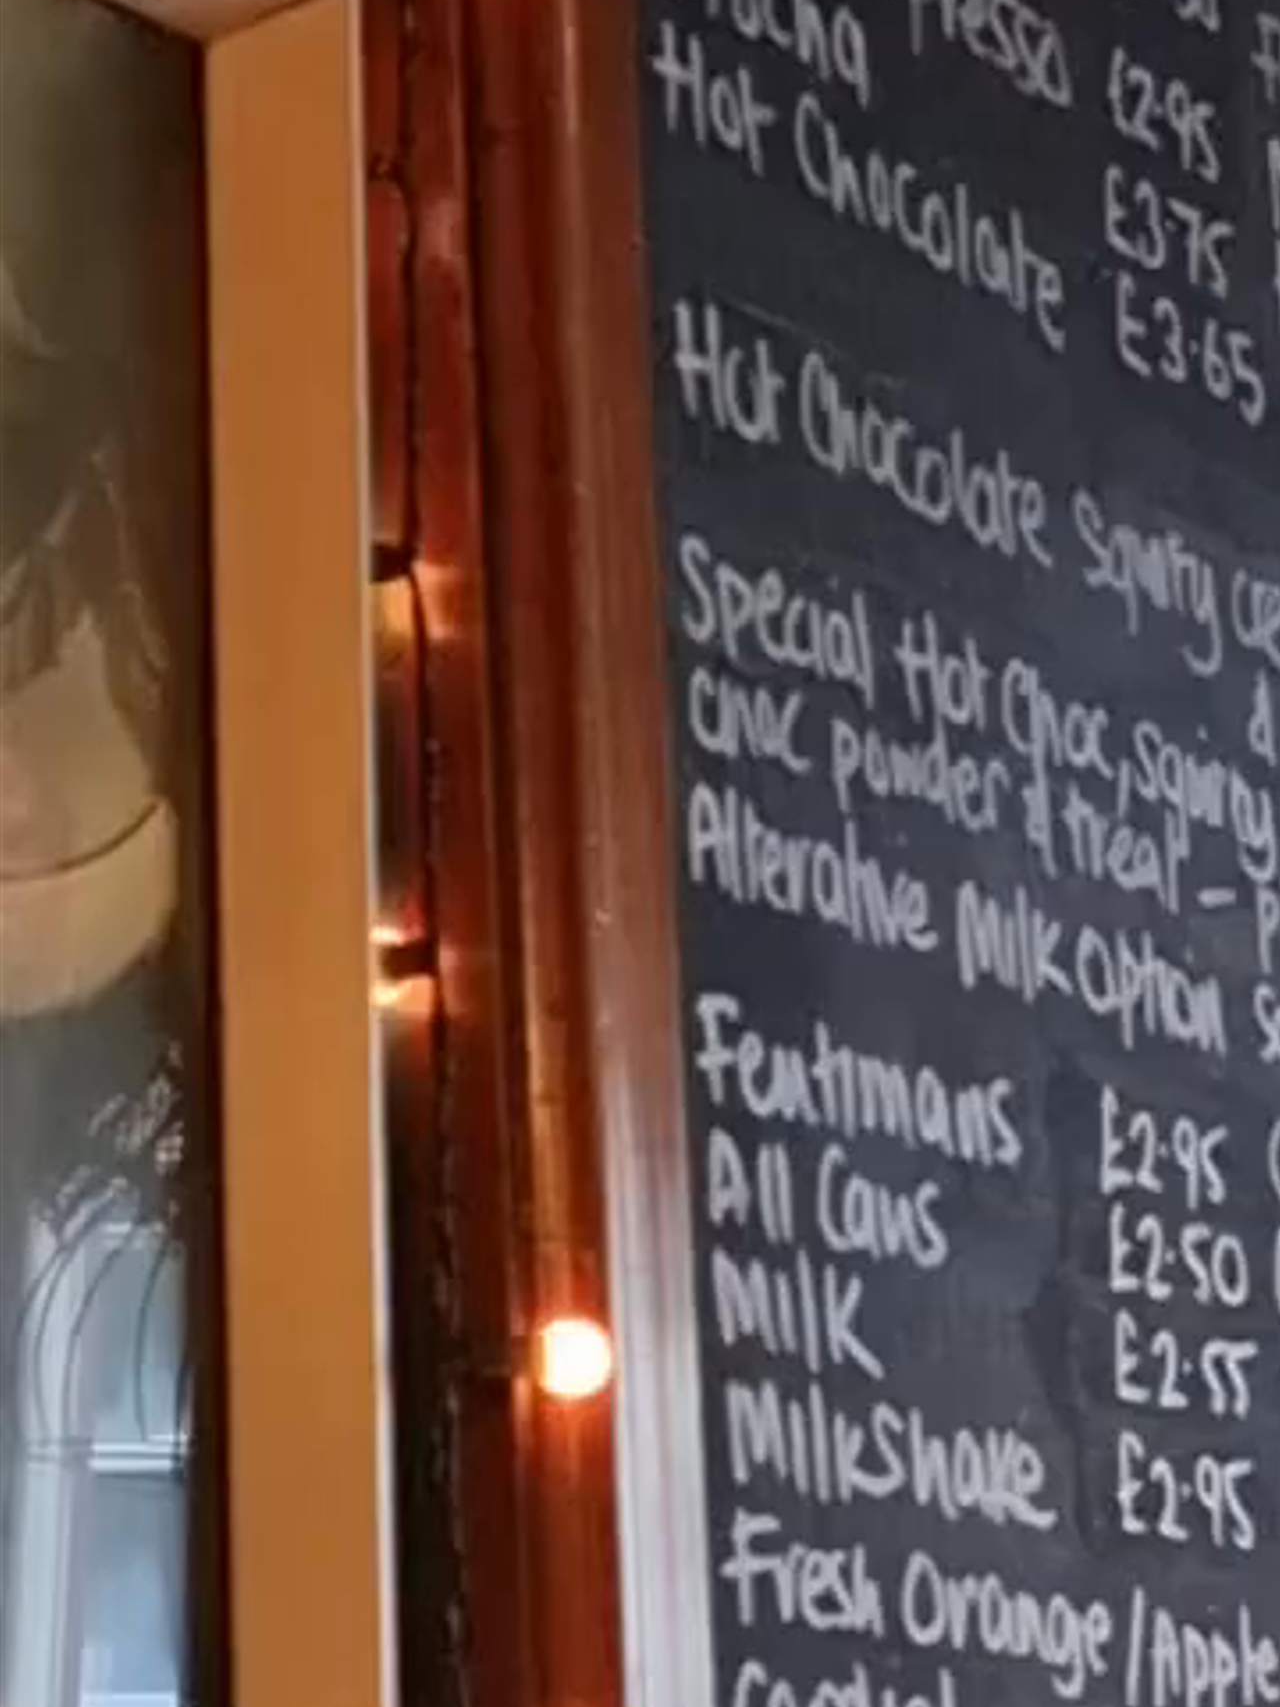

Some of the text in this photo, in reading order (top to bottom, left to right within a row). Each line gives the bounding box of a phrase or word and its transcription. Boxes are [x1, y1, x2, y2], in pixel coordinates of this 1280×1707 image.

[652, 21, 1266, 425] Hot Chocolate £3.65
[1103, 164, 1233, 297] £3.75
[673, 300, 783, 442] Hot
[799, 352, 1052, 566] Chocolate
[679, 534, 874, 702] Special
[894, 611, 989, 730] Hot
[830, 718, 1009, 831] powder
[697, 993, 1021, 1165] Fentimans
[1099, 1084, 1227, 1207] £2.95
[707, 1128, 793, 1240] All
[816, 1144, 948, 1268] Cans
[1108, 1203, 1249, 1306] £2.50
[1113, 1309, 1258, 1417] £2.55
[1116, 1430, 1255, 1550] £2.95
[722, 1510, 883, 1633] Fresh
